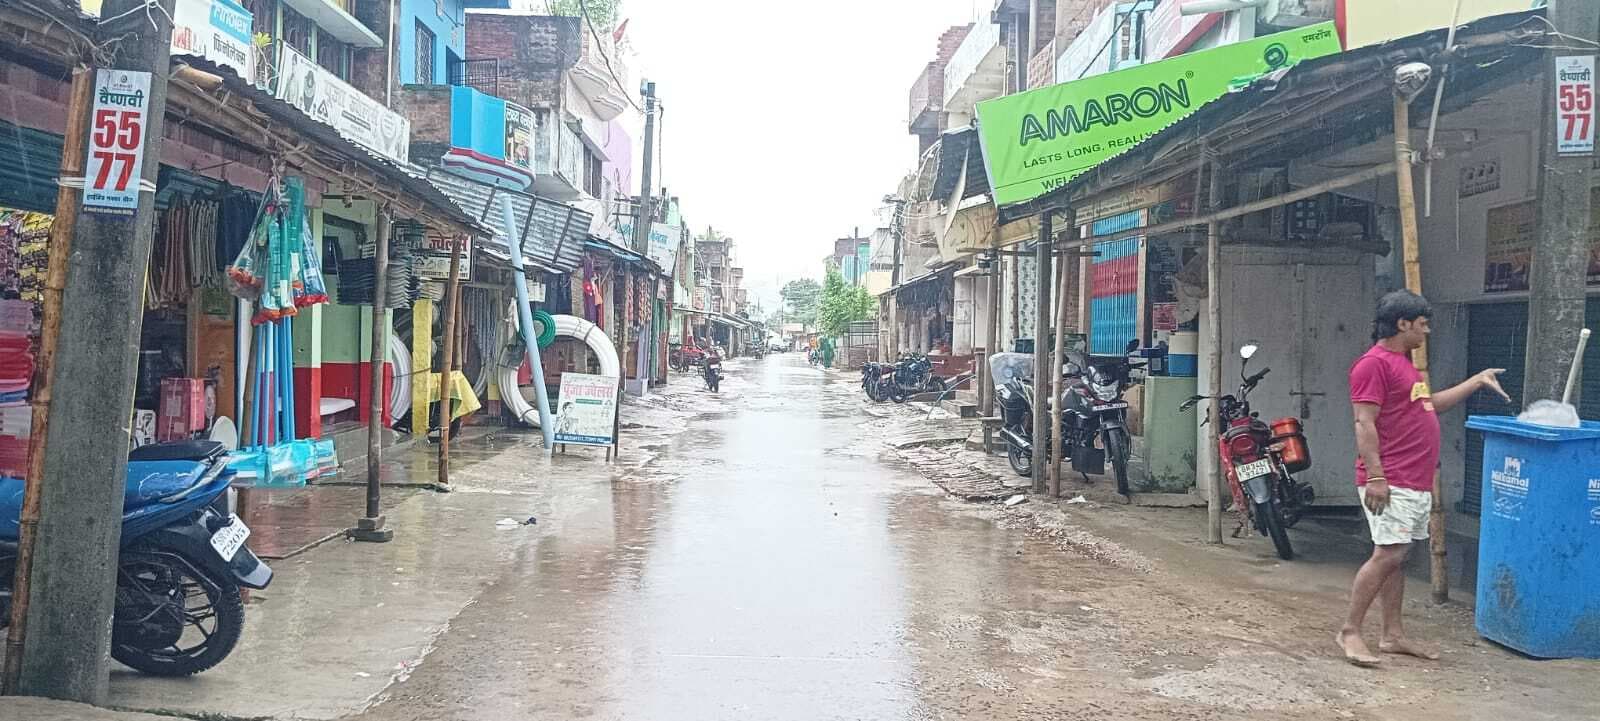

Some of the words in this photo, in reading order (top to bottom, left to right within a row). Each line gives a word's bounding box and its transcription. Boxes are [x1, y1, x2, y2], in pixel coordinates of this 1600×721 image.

[1302, 28, 1332, 43] एमरॉन
[99, 86, 144, 107] वैष्णवी
[1560, 84, 1591, 111] 55
[1020, 78, 1191, 146] AMARON
[94, 109, 141, 150] 55
[1562, 114, 1590, 140] 77
[1023, 153, 1062, 169] LASTS
[1066, 144, 1105, 160] LONG,
[93, 151, 136, 191] 77
[1491, 469, 1529, 488] Nilkamal
